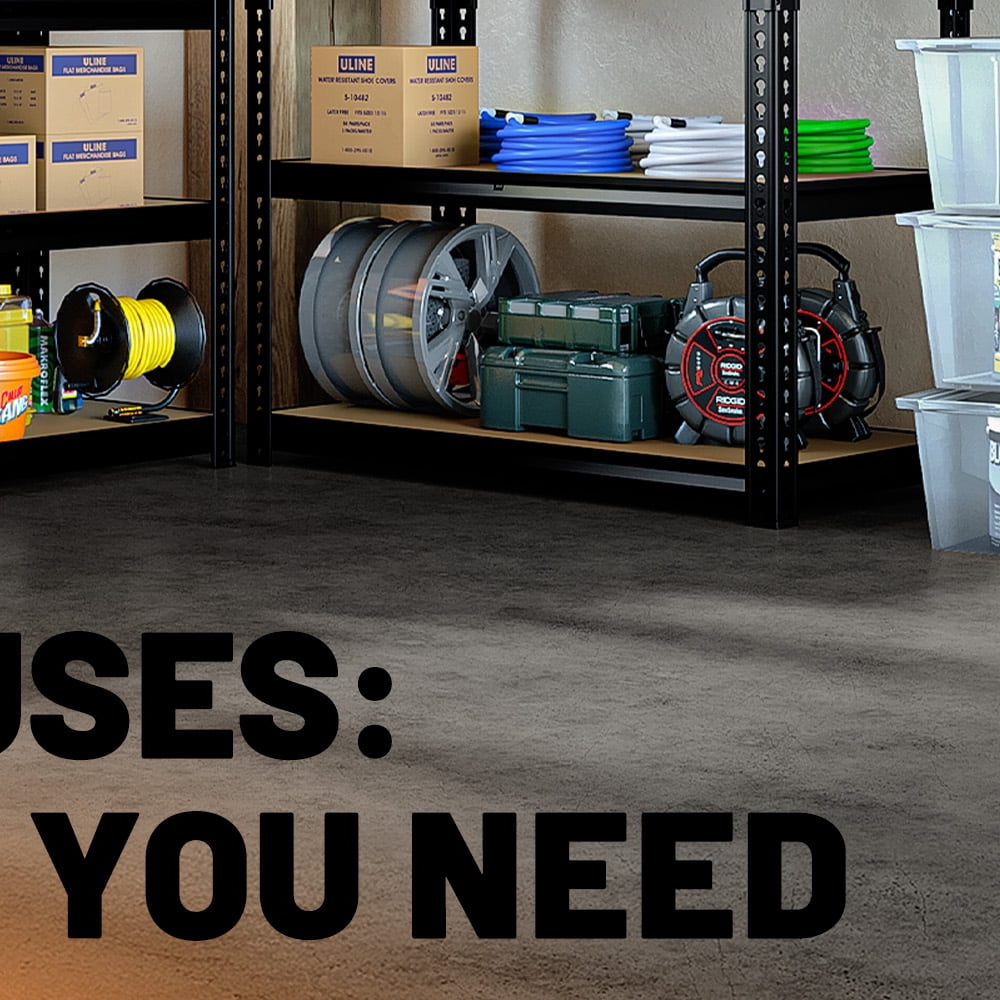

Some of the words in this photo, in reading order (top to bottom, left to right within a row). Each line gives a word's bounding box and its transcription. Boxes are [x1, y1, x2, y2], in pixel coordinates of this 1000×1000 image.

[83, 57, 107, 66] ULINE
[340, 58, 374, 71] ULINE
[428, 58, 455, 71] ULINE
[83, 142, 107, 151] ULINE
[716, 396, 745, 406] RIDGID
